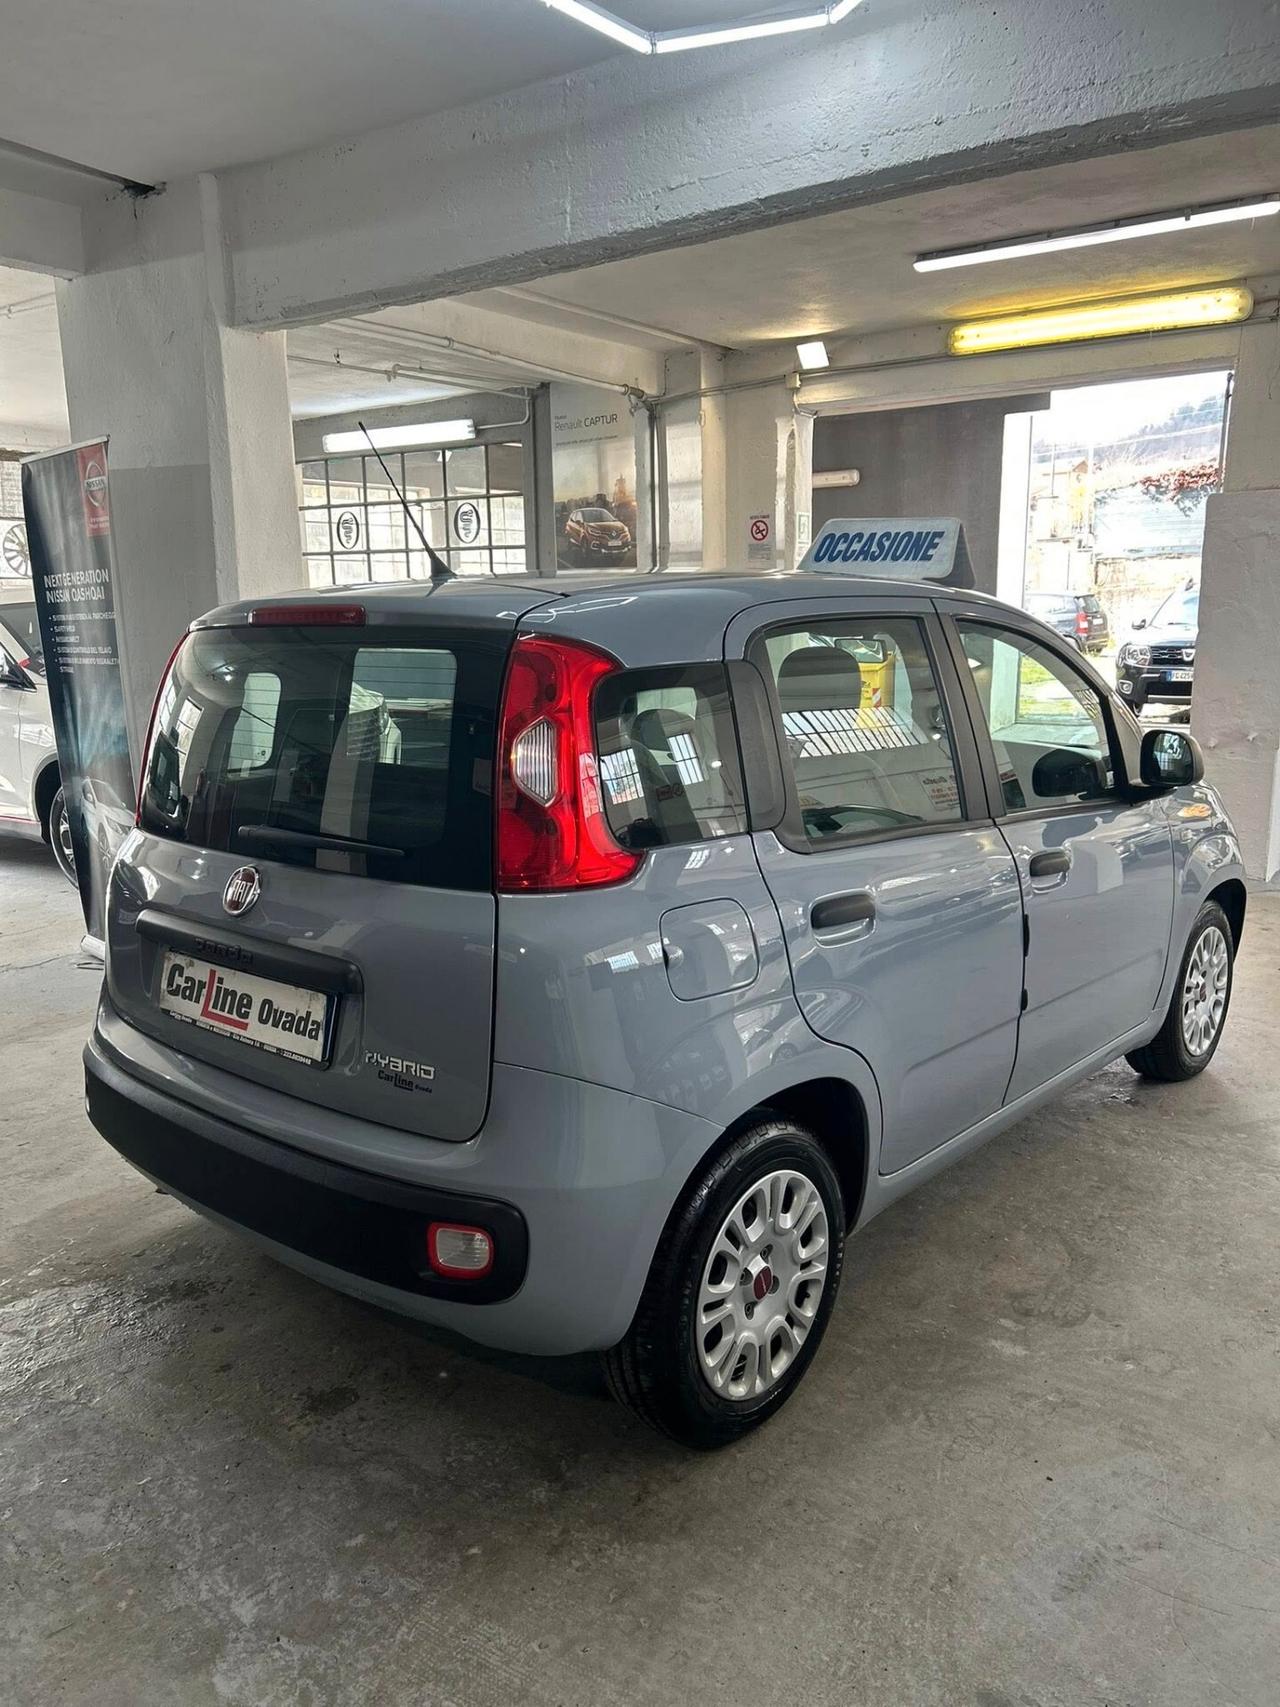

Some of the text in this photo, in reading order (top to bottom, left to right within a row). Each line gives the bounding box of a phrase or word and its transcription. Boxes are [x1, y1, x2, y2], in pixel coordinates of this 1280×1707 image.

[583, 413, 618, 427] CAPTUR
[813, 530, 945, 563] OCCASIONE
[43, 568, 109, 588] NEXT GENERATION
[45, 586, 105, 604] NISSAN QASHQAI
[257, 997, 321, 1041] Ovada
